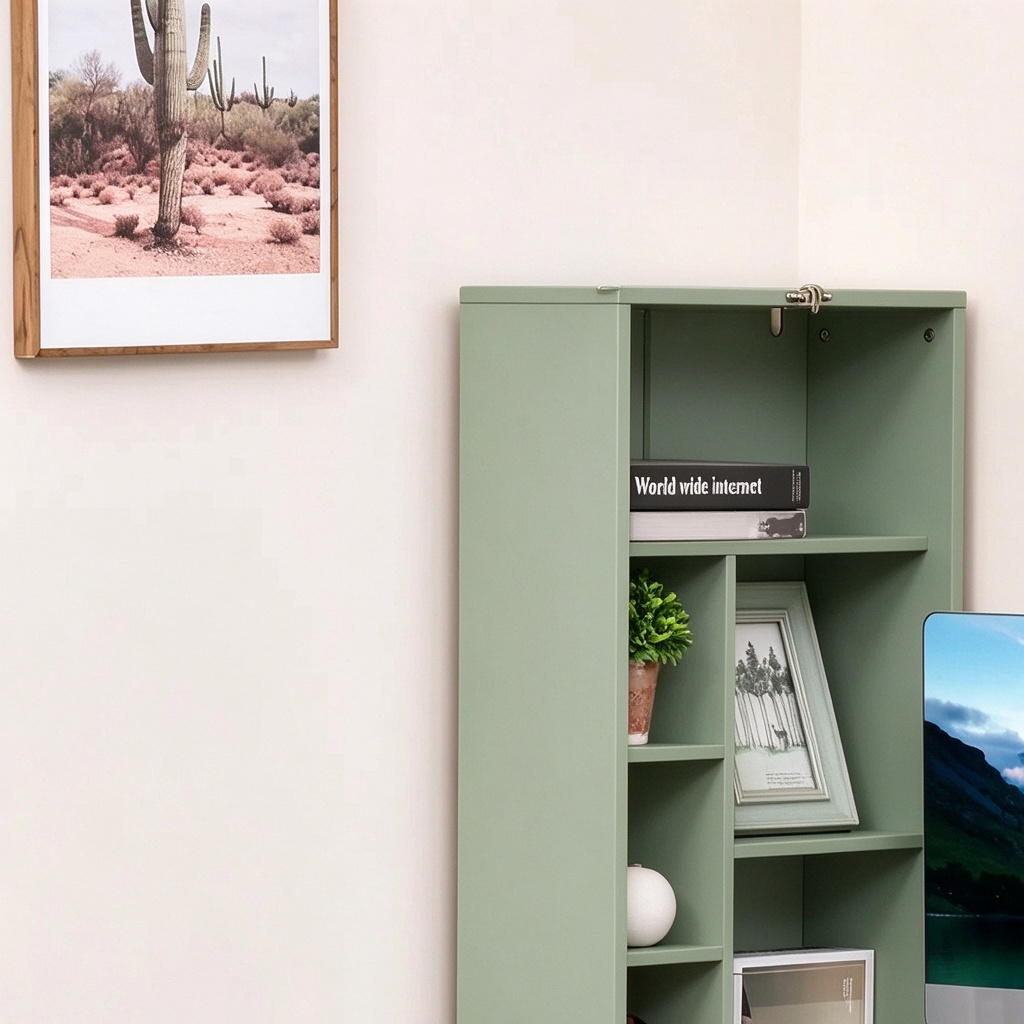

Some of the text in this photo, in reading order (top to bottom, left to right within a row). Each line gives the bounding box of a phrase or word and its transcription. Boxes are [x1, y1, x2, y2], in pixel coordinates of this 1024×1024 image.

[635, 476, 762, 495] World wide internet
